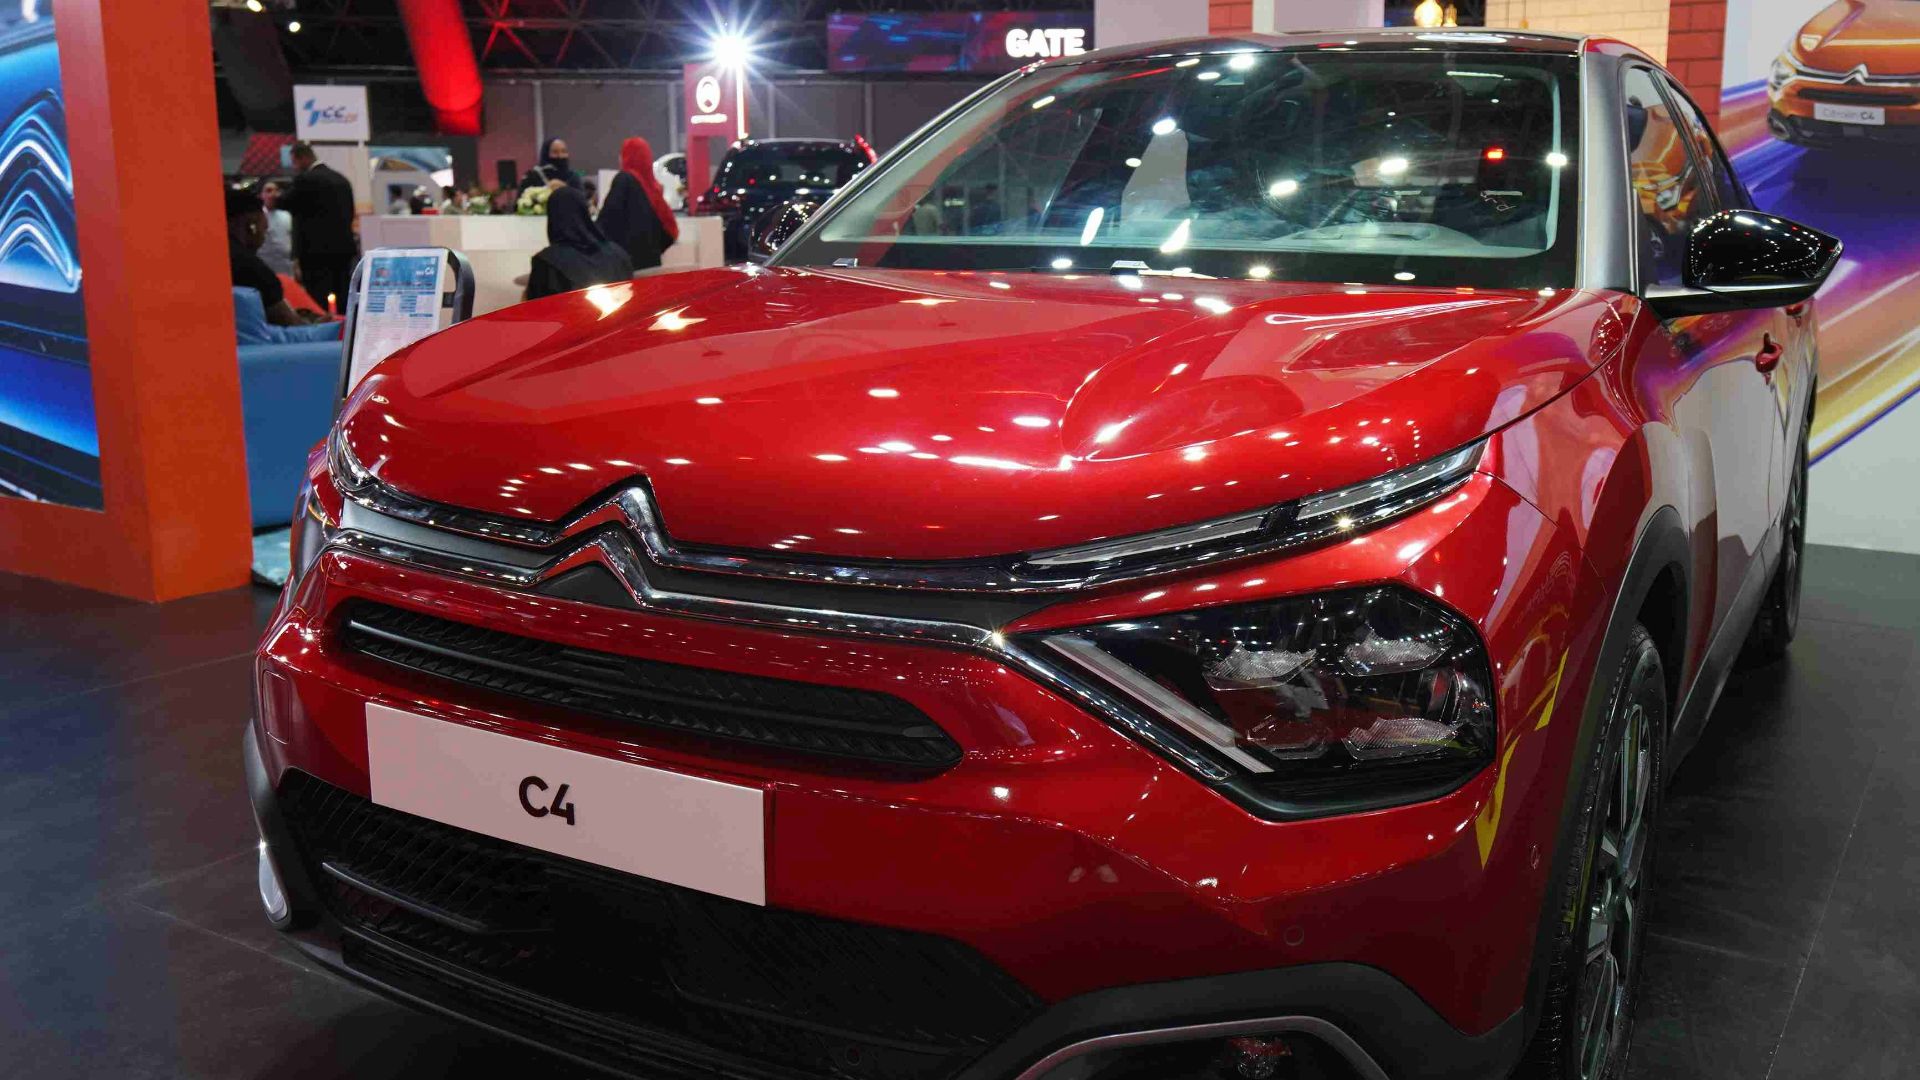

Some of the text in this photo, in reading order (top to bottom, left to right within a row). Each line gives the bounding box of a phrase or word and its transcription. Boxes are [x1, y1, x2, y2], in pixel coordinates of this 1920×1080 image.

[1005, 29, 1085, 57] GATE
[1860, 112, 1875, 120] C4
[519, 776, 575, 825] C4
